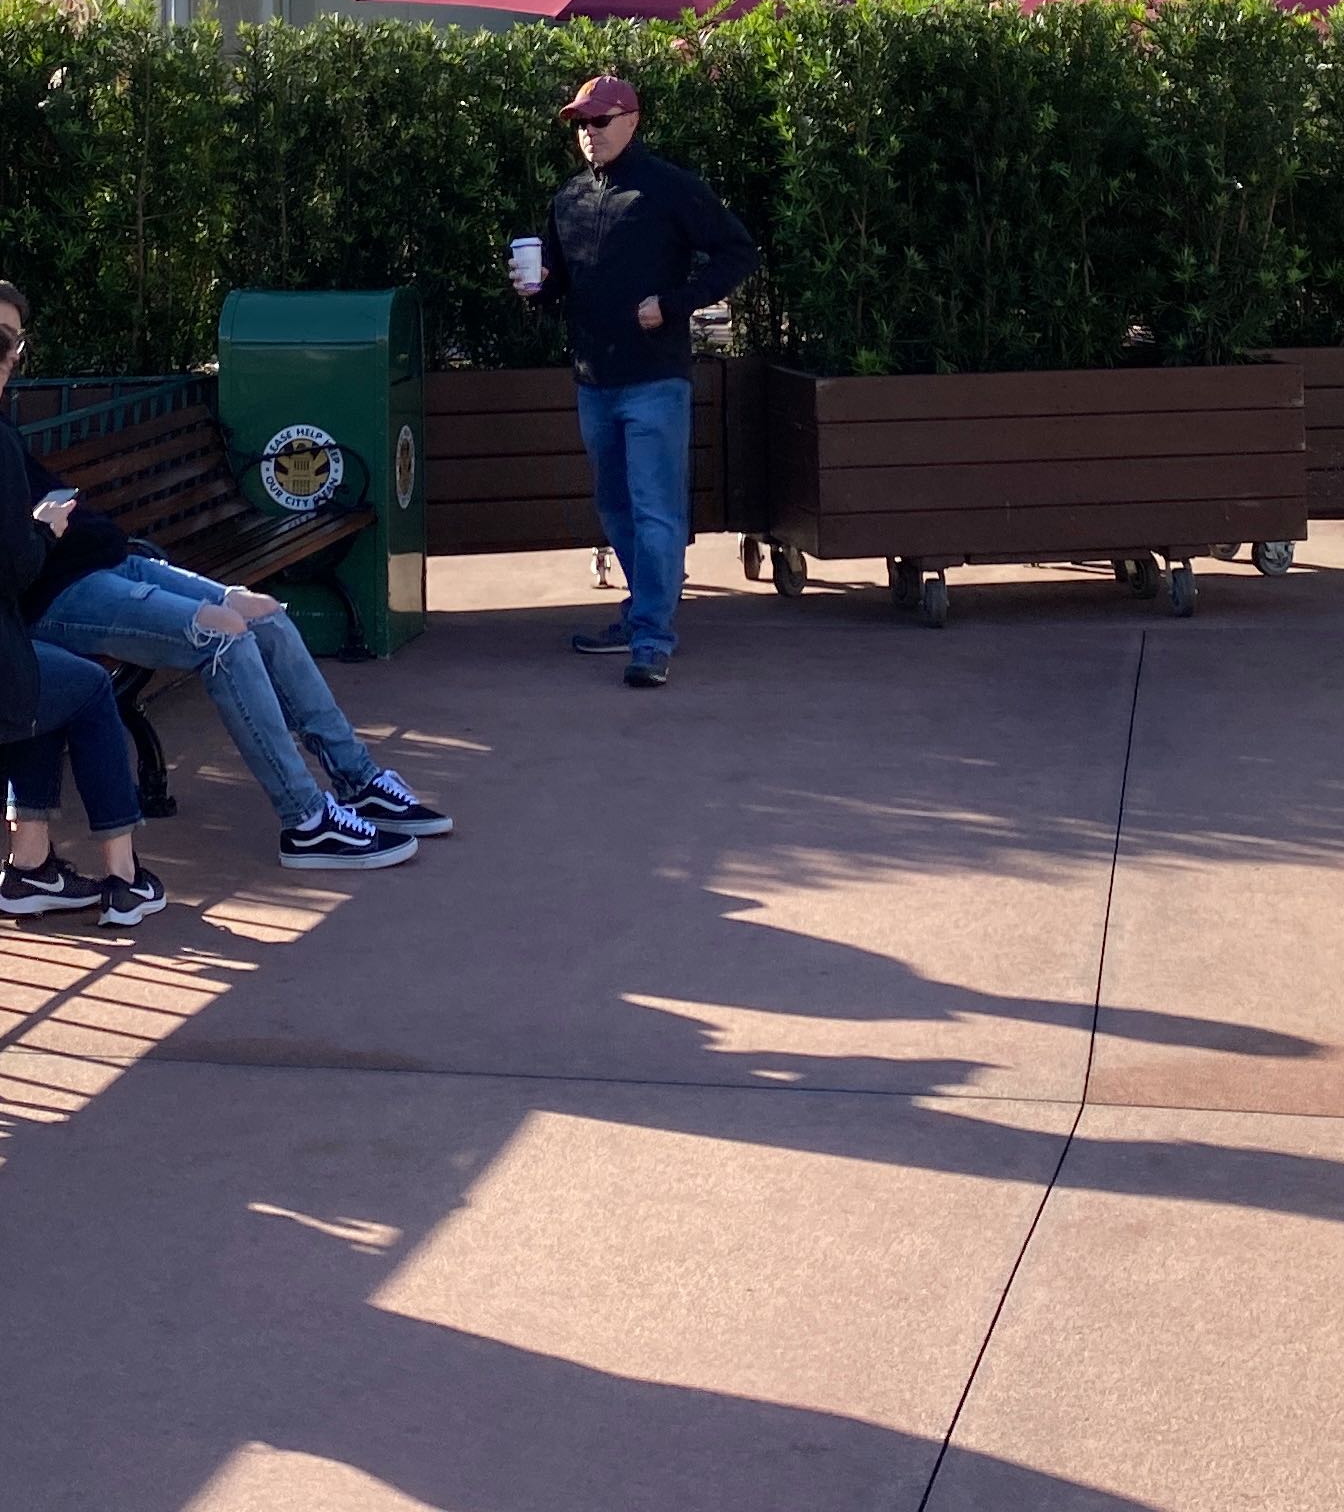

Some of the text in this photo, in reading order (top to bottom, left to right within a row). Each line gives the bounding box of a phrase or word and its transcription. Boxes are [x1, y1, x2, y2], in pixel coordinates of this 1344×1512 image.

[263, 430, 292, 458] EASE
[296, 428, 323, 439] HELP
[266, 475, 284, 498] OUR
[285, 496, 309, 507] CITY
